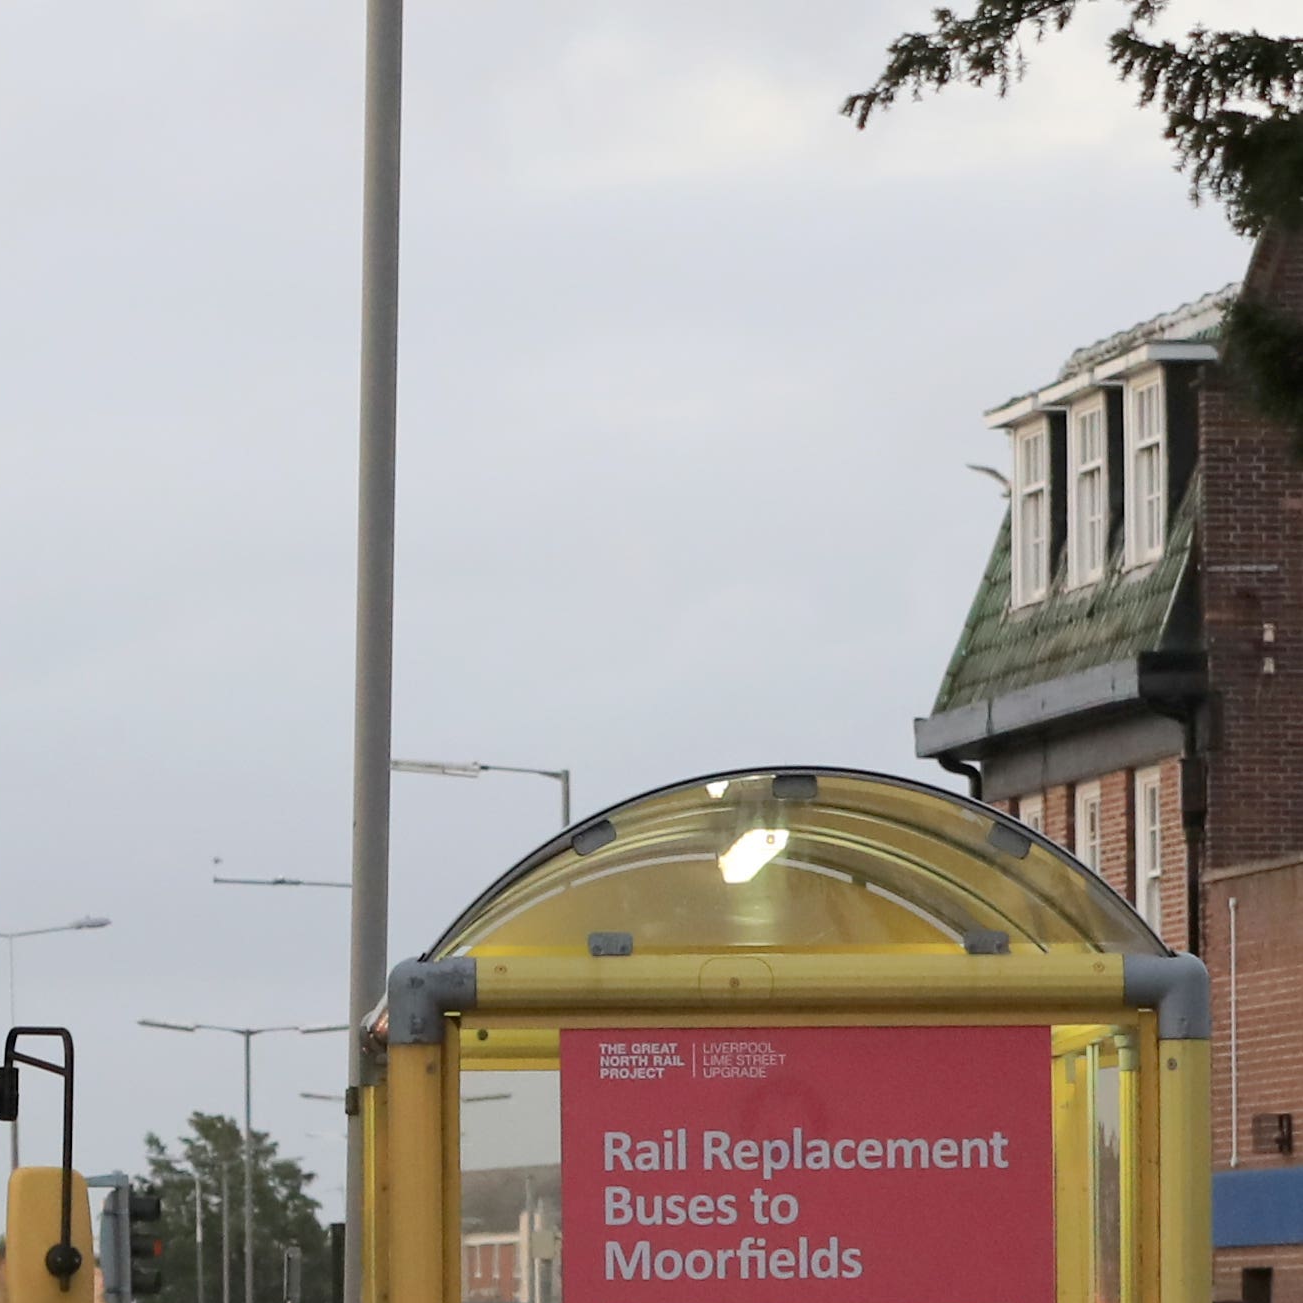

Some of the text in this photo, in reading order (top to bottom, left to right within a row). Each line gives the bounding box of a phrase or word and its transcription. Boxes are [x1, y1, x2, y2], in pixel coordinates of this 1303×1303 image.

[599, 1043, 678, 1054] THE GREAT
[703, 1042, 776, 1054] LIVERPOOL
[600, 1055, 685, 1066] NORTH RAIL
[703, 1054, 787, 1066] LIME STREET
[600, 1067, 665, 1079] PROJECT
[703, 1067, 767, 1078] UPGRADE
[603, 1127, 1010, 1180] Rail Replacement
[604, 1185, 799, 1226] Buses to
[605, 1235, 863, 1281] Moorfields
